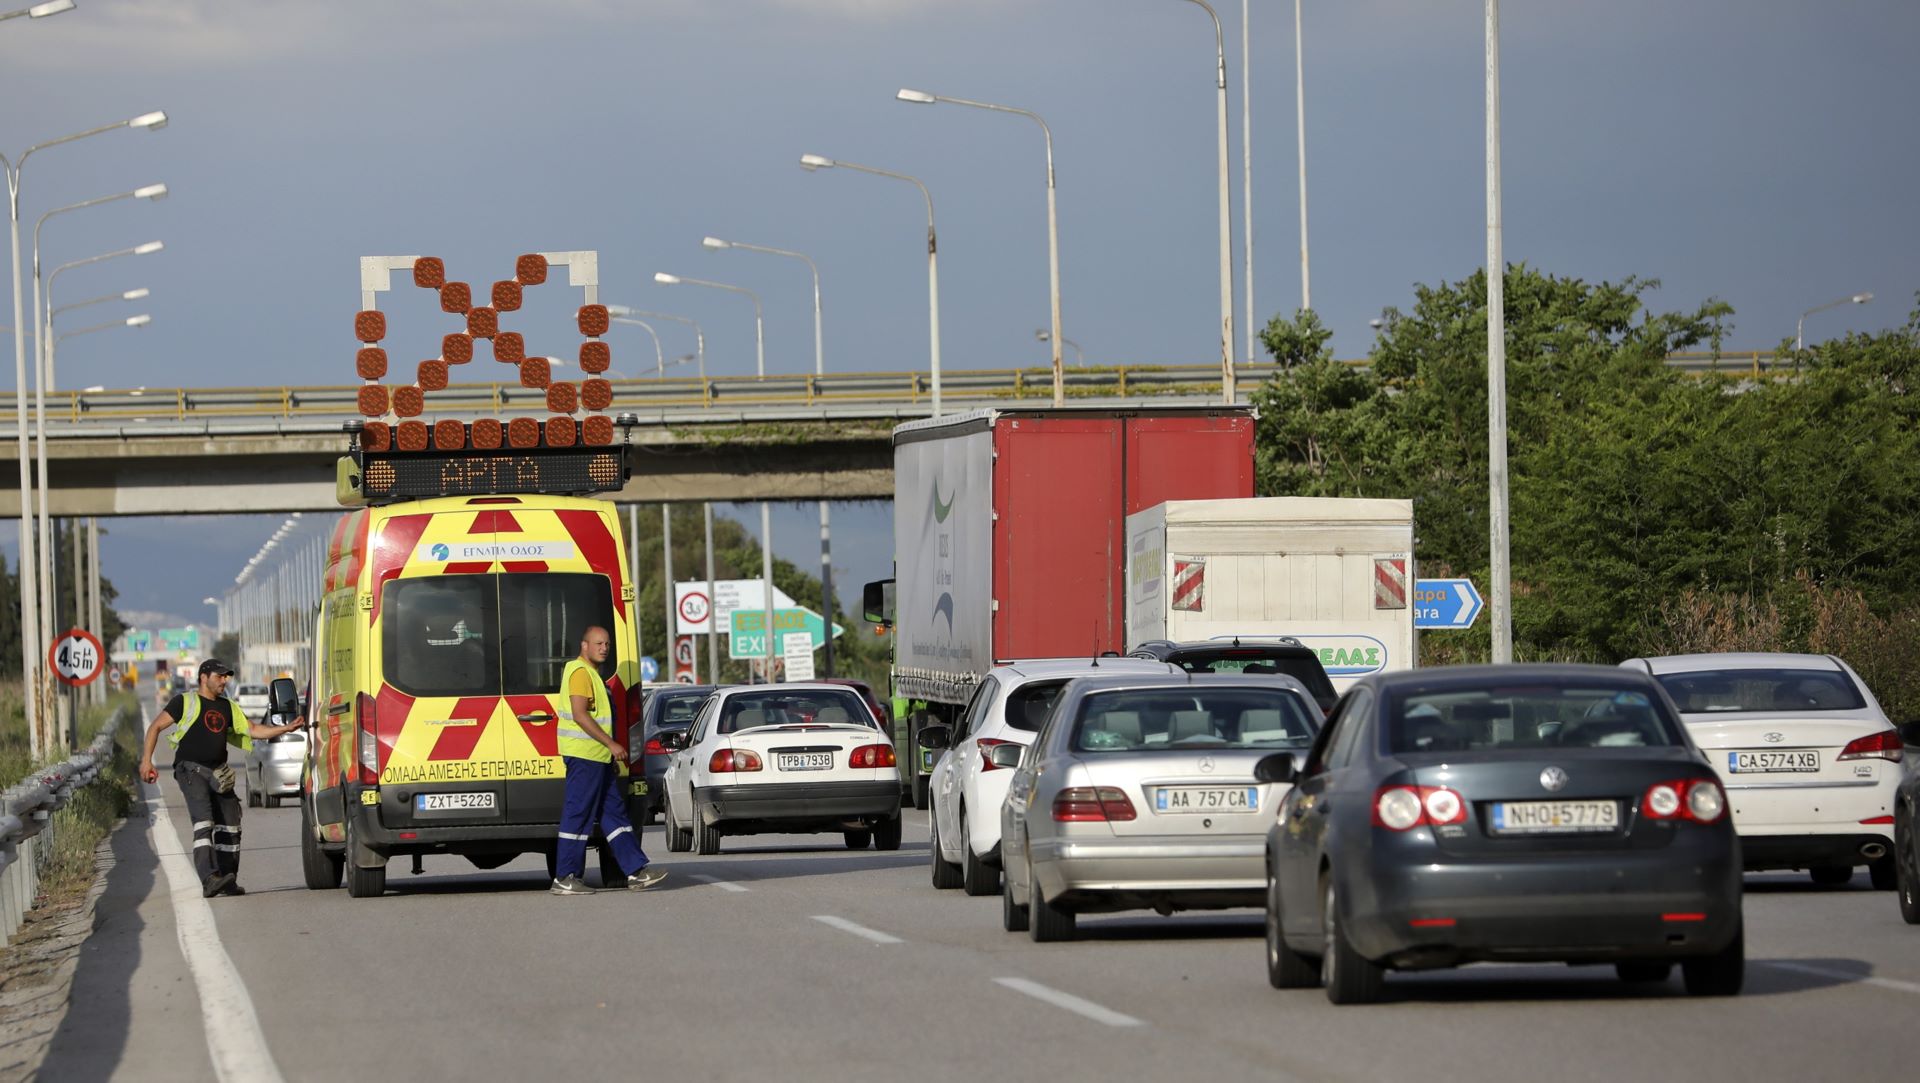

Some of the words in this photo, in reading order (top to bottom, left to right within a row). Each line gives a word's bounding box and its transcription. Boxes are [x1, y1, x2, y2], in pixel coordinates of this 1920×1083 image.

[441, 456, 539, 490] ΑΡΓΑ
[510, 545, 544, 556] ΟΔΟΣ
[736, 635, 777, 653] EXI
[1313, 647, 1380, 666] ΕΛΑΣ
[1760, 753, 1795, 767] 5774
[384, 765, 426, 783] ΟΜΑΔΑ
[429, 762, 477, 782] ΑΜΕΣΗΣ
[481, 759, 554, 778] ΕΠΕΜΒΑΣΗΣ
